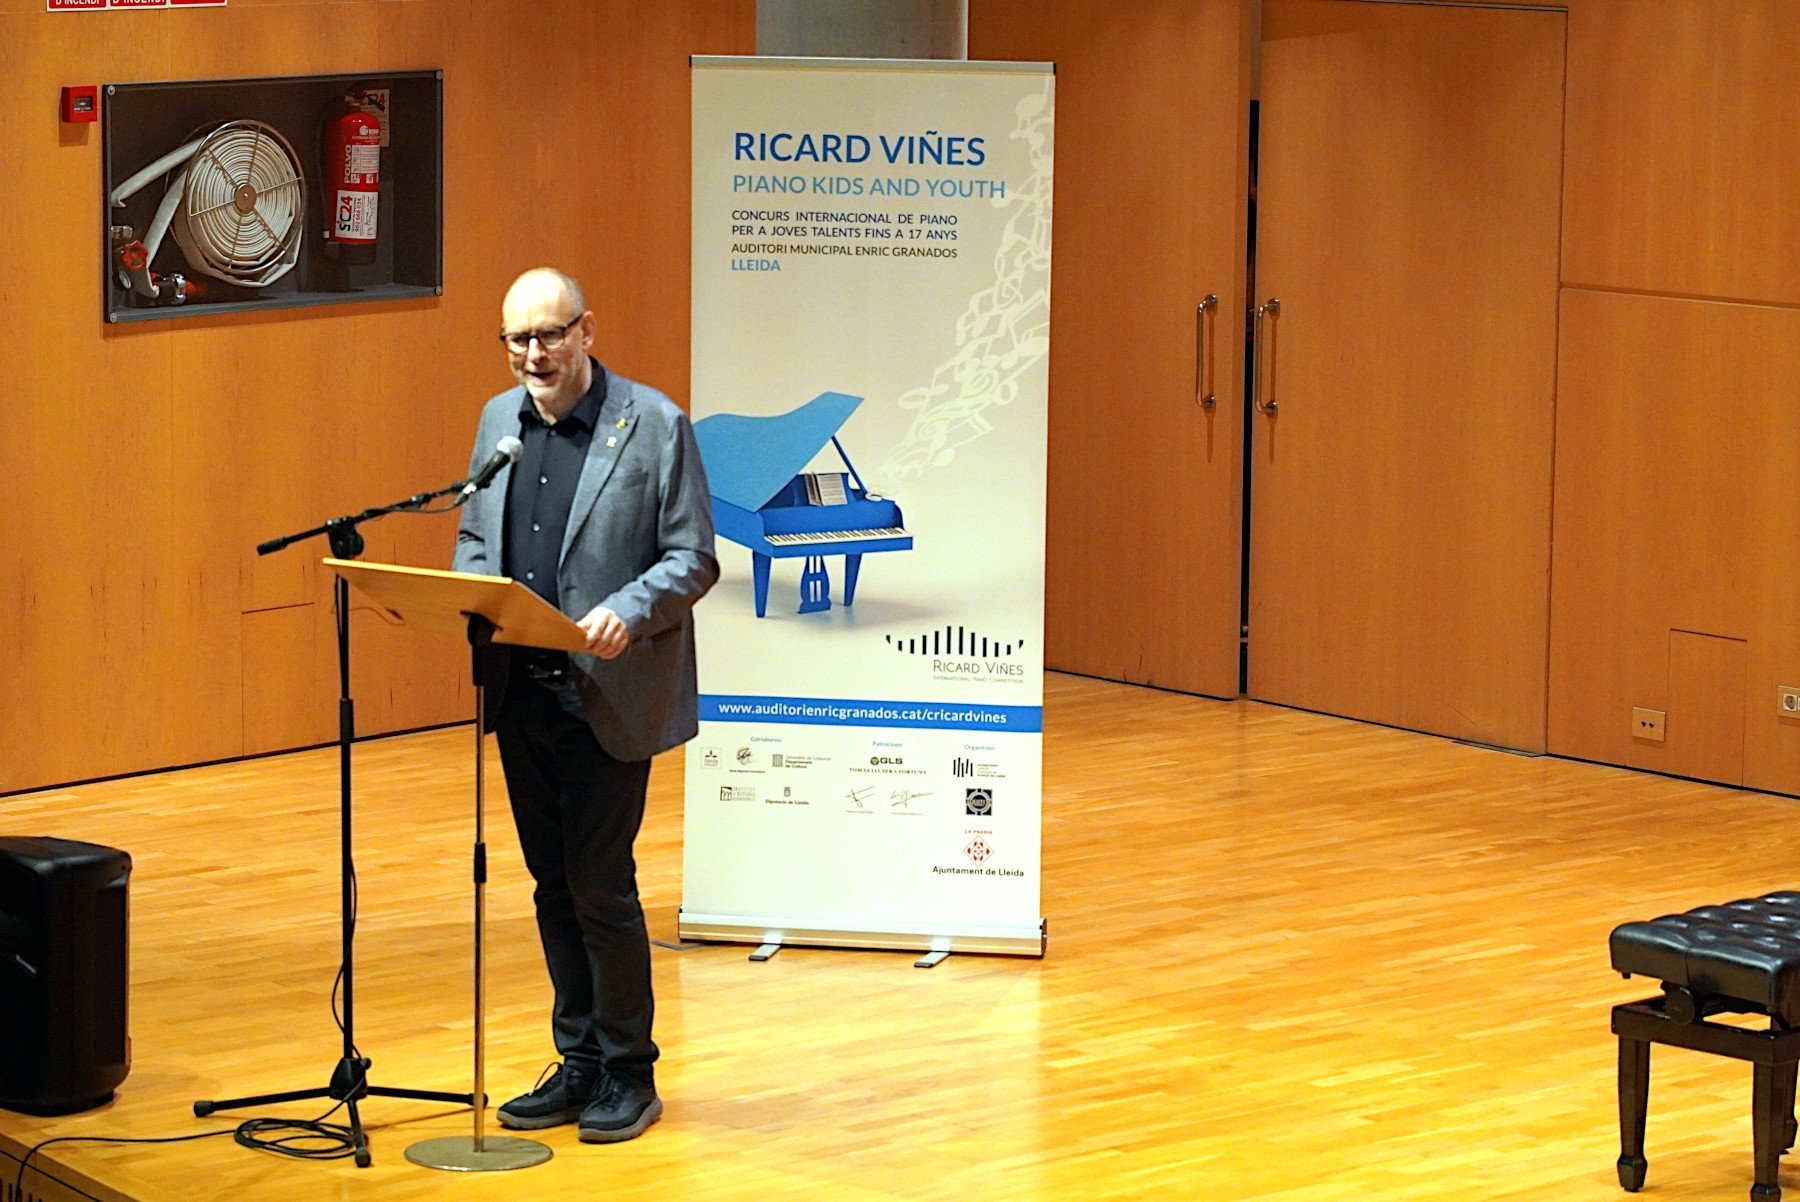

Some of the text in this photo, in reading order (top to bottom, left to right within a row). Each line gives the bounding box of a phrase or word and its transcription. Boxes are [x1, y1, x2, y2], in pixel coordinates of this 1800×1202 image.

[736, 131, 984, 166] RICARD VIÑES
[734, 175, 1006, 199] PIANO KIDS AND YOUTH
[732, 211, 957, 225] CONCURS INTERNACIONAL DE PIANO
[732, 225, 957, 240] PER A JOVES TALENTS FINS A 17 ANYS
[732, 244, 957, 258] AUDITORI MUNICIPAL ENRIC GRANADOS
[732, 259, 780, 271] LLEIDA
[934, 659, 1023, 675] RICARD VIÑES
[719, 703, 1006, 723] www.auditorienricgranados.cat/cricardvines
[933, 866, 982, 874] Ajuntament
